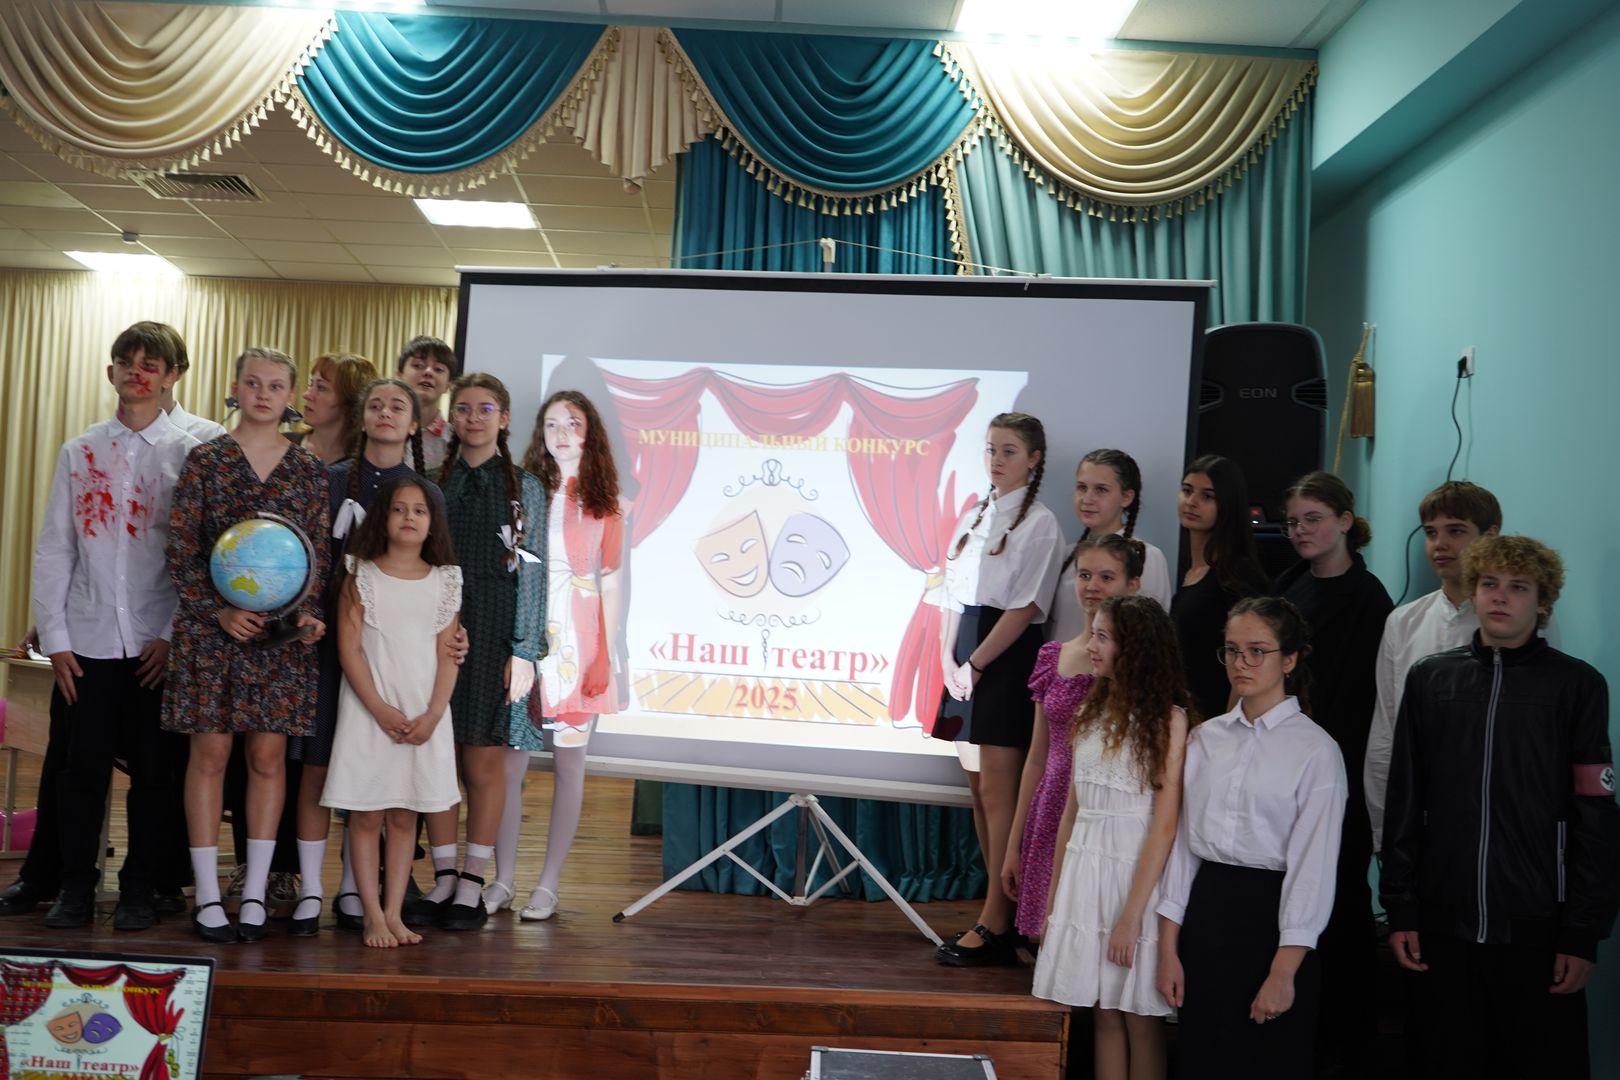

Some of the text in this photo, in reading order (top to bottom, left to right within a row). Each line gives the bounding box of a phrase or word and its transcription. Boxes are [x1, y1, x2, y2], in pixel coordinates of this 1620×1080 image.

[1239, 388, 1277, 399] EON
[638, 429, 931, 456] МУНИЦИПАЛЬНЫЙ КОНКУРС
[649, 632, 889, 681] «Наш театр»
[734, 684, 798, 711] 2025
